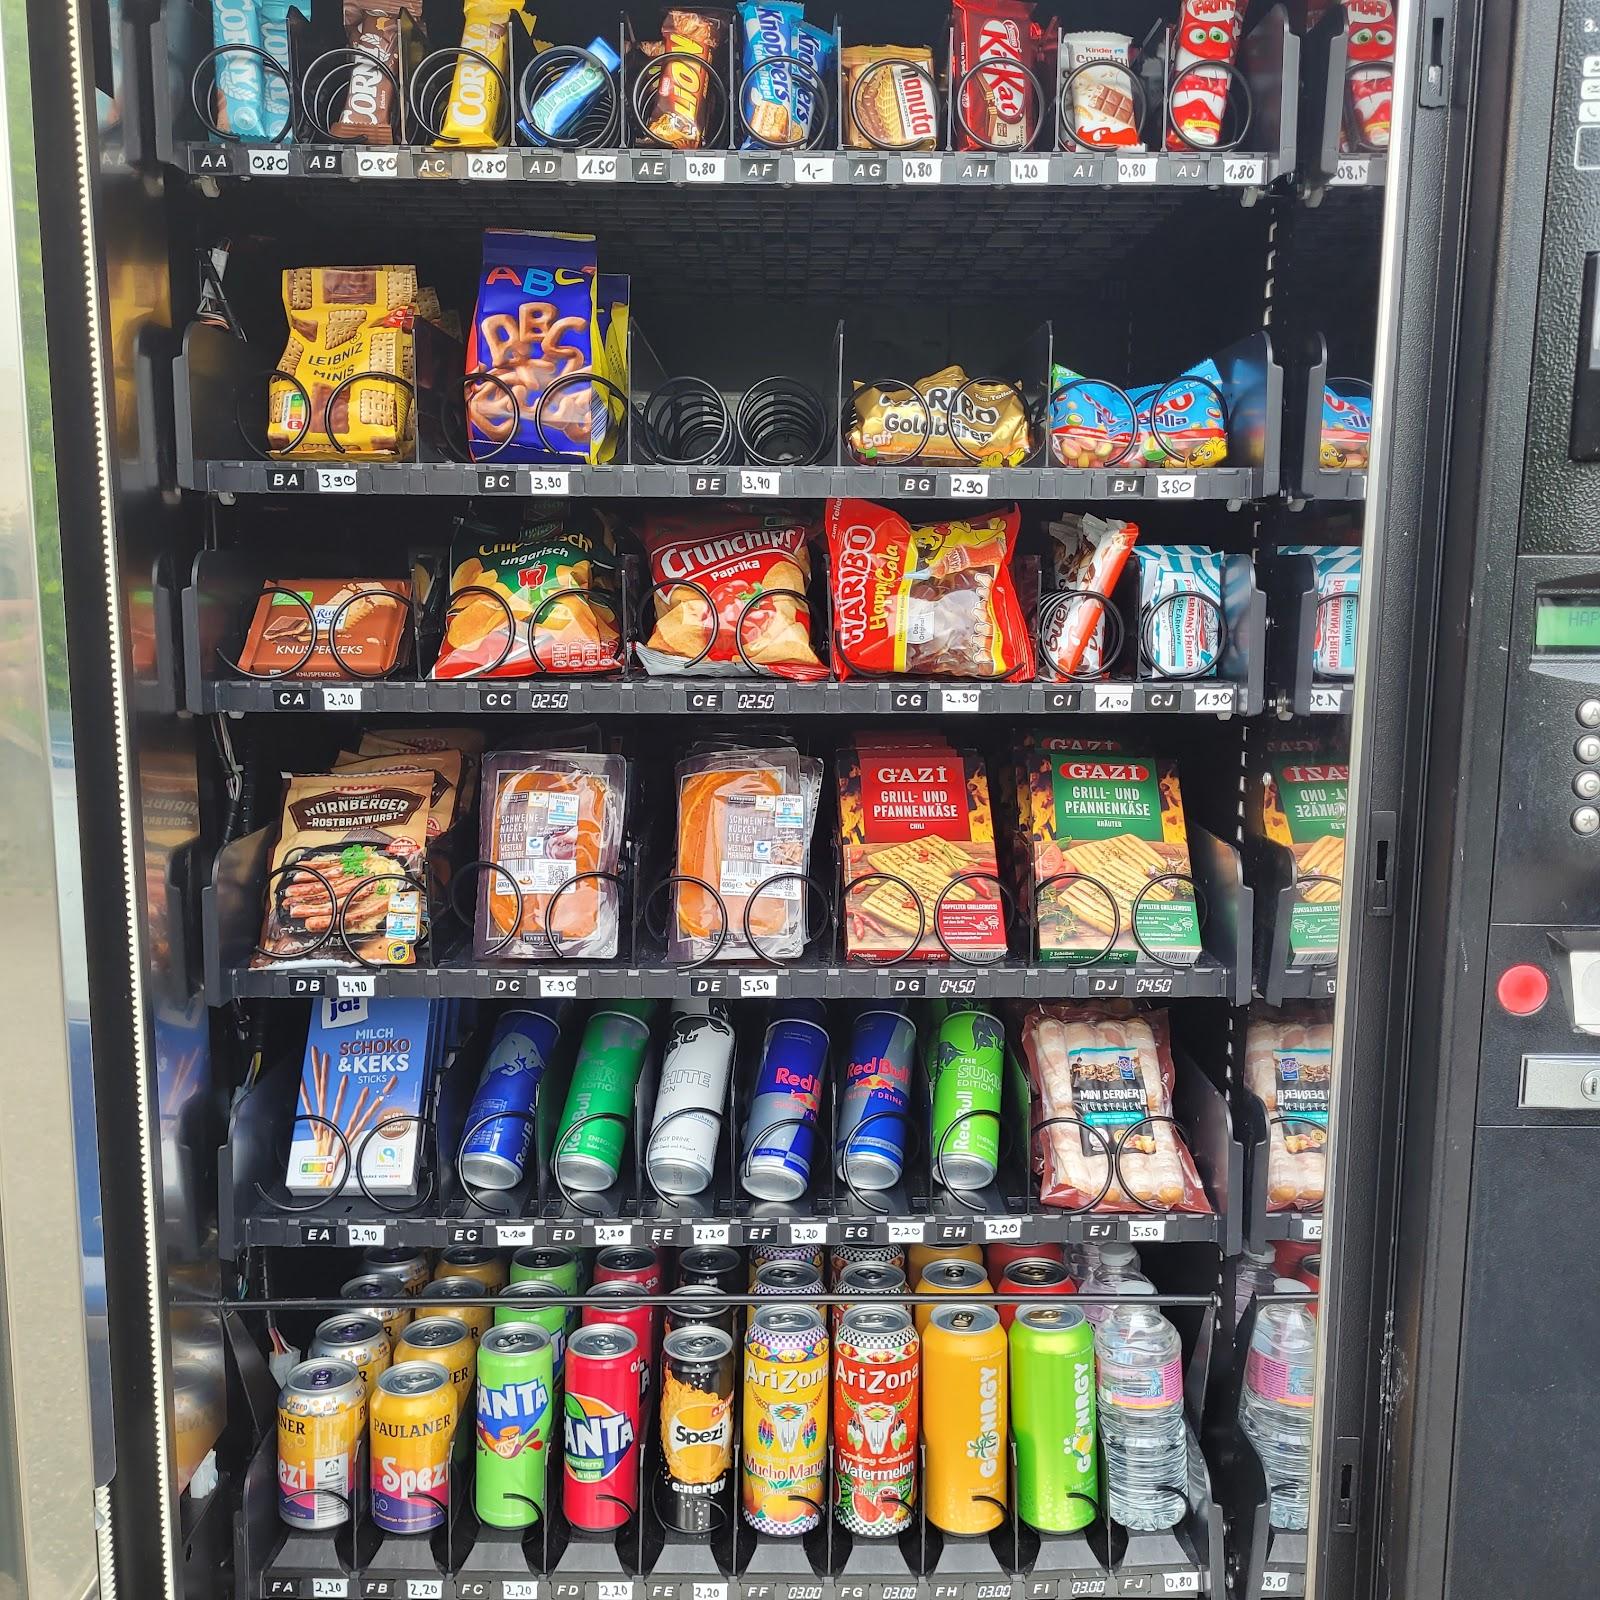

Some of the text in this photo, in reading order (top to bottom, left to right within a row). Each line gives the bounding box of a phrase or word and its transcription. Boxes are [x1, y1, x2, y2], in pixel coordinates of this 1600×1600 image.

[671, 34, 704, 119] LION
[308, 342, 364, 366] LEIBNIZ
[313, 364, 355, 382] MINIS
[863, 431, 893, 449] Saft
[501, 546, 569, 566] ungarisch
[660, 529, 796, 578] Crunchips
[710, 559, 760, 581] Paprika
[839, 524, 876, 650] HARIBO
[1174, 598, 1184, 646] SPEARMINT
[1185, 635, 1195, 668] FRIEND
[531, 694, 568, 708] 02.50
[738, 694, 774, 709] 02.50
[1587, 744, 1598, 757] D
[880, 790, 948, 803] GRILL- UND
[1072, 787, 1140, 801] GRILL- UND
[304, 798, 410, 817] NÜRNBERGER
[873, 803, 958, 818] PFANNENKÄSE
[1064, 800, 1150, 816] PFANNENKÄSE
[909, 822, 925, 830] CHILI
[1096, 820, 1122, 828] KRÄUTER
[500, 833, 524, 842] STEAKS
[940, 979, 975, 993] 04.50
[1136, 979, 1172, 992] 04.50
[330, 996, 361, 1022] ja!
[355, 1028, 394, 1040] MILCH
[339, 1038, 411, 1056] SCHOKO
[358, 1074, 387, 1084] STICKS
[662, 1069, 712, 1089] HITE
[775, 1067, 812, 1090] Red
[847, 1057, 909, 1084] Red Bull
[957, 1079, 994, 1094] EDITION
[1080, 1088, 1140, 1101] MINI BERNER
[878, 1091, 903, 1105] DRINK
[1081, 1101, 1142, 1112] WÜRSTCHEN
[745, 1359, 829, 1394] AriZona
[835, 1359, 919, 1394] AriZona
[477, 1378, 549, 1420] ANTA
[374, 1413, 451, 1439] PAULANER
[565, 1412, 634, 1457] ANTA
[675, 1422, 724, 1445] Spezi
[840, 1448, 877, 1466] Cowboy
[746, 1454, 786, 1480] Mucho
[838, 1457, 914, 1482] Watermelon
[788, 1586, 822, 1599] 03.00
[883, 1586, 916, 1599] 03.00
[978, 1585, 1011, 1598] 03.00
[1072, 1581, 1105, 1593] 03.00
